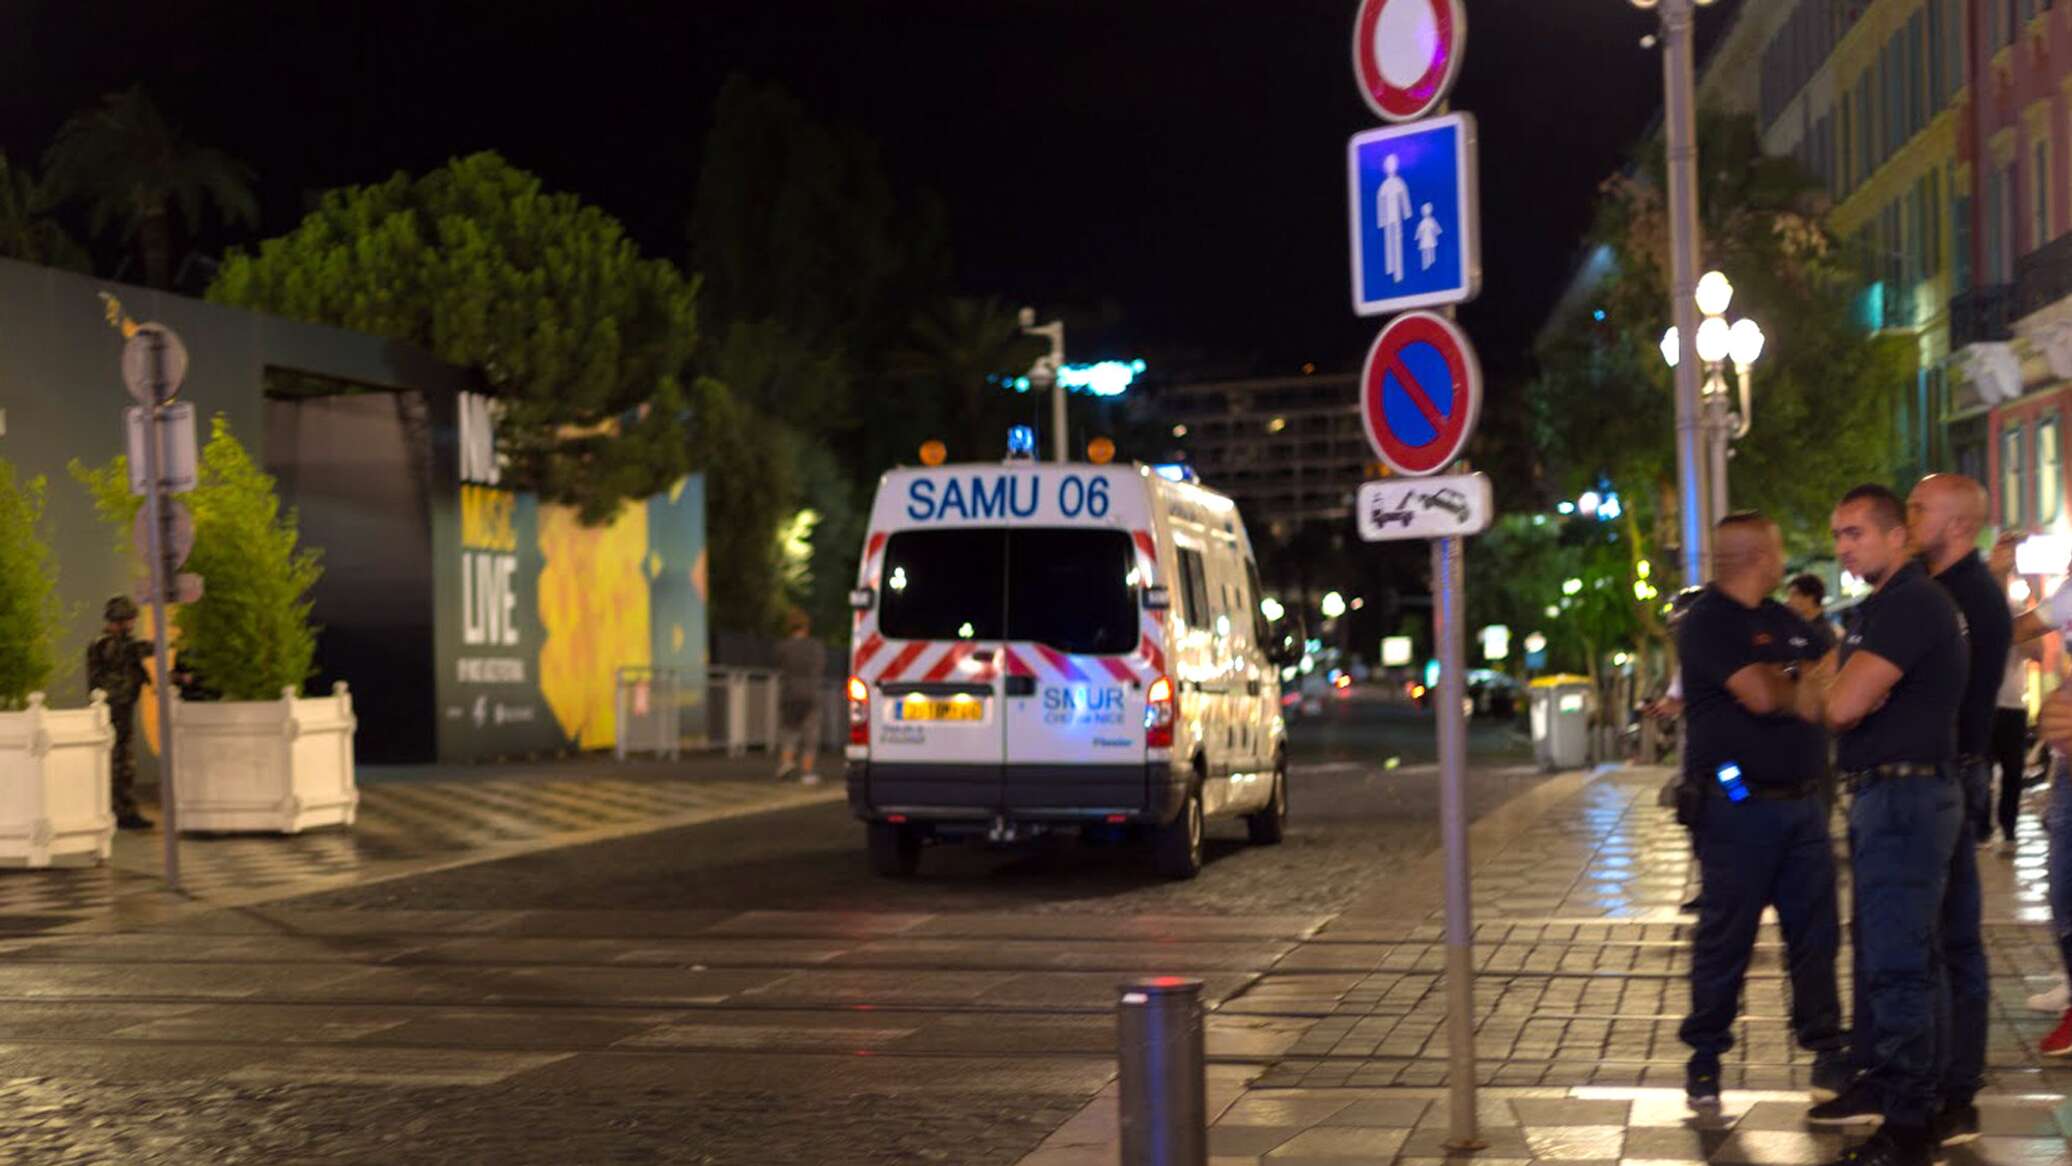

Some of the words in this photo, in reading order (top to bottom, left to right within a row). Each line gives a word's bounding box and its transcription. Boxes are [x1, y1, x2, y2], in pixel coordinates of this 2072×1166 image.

[907, 475, 1040, 521] SAMU
[1059, 474, 1110, 519] 06
[463, 553, 518, 645] LIVE
[1043, 686, 1125, 710] SMUR
